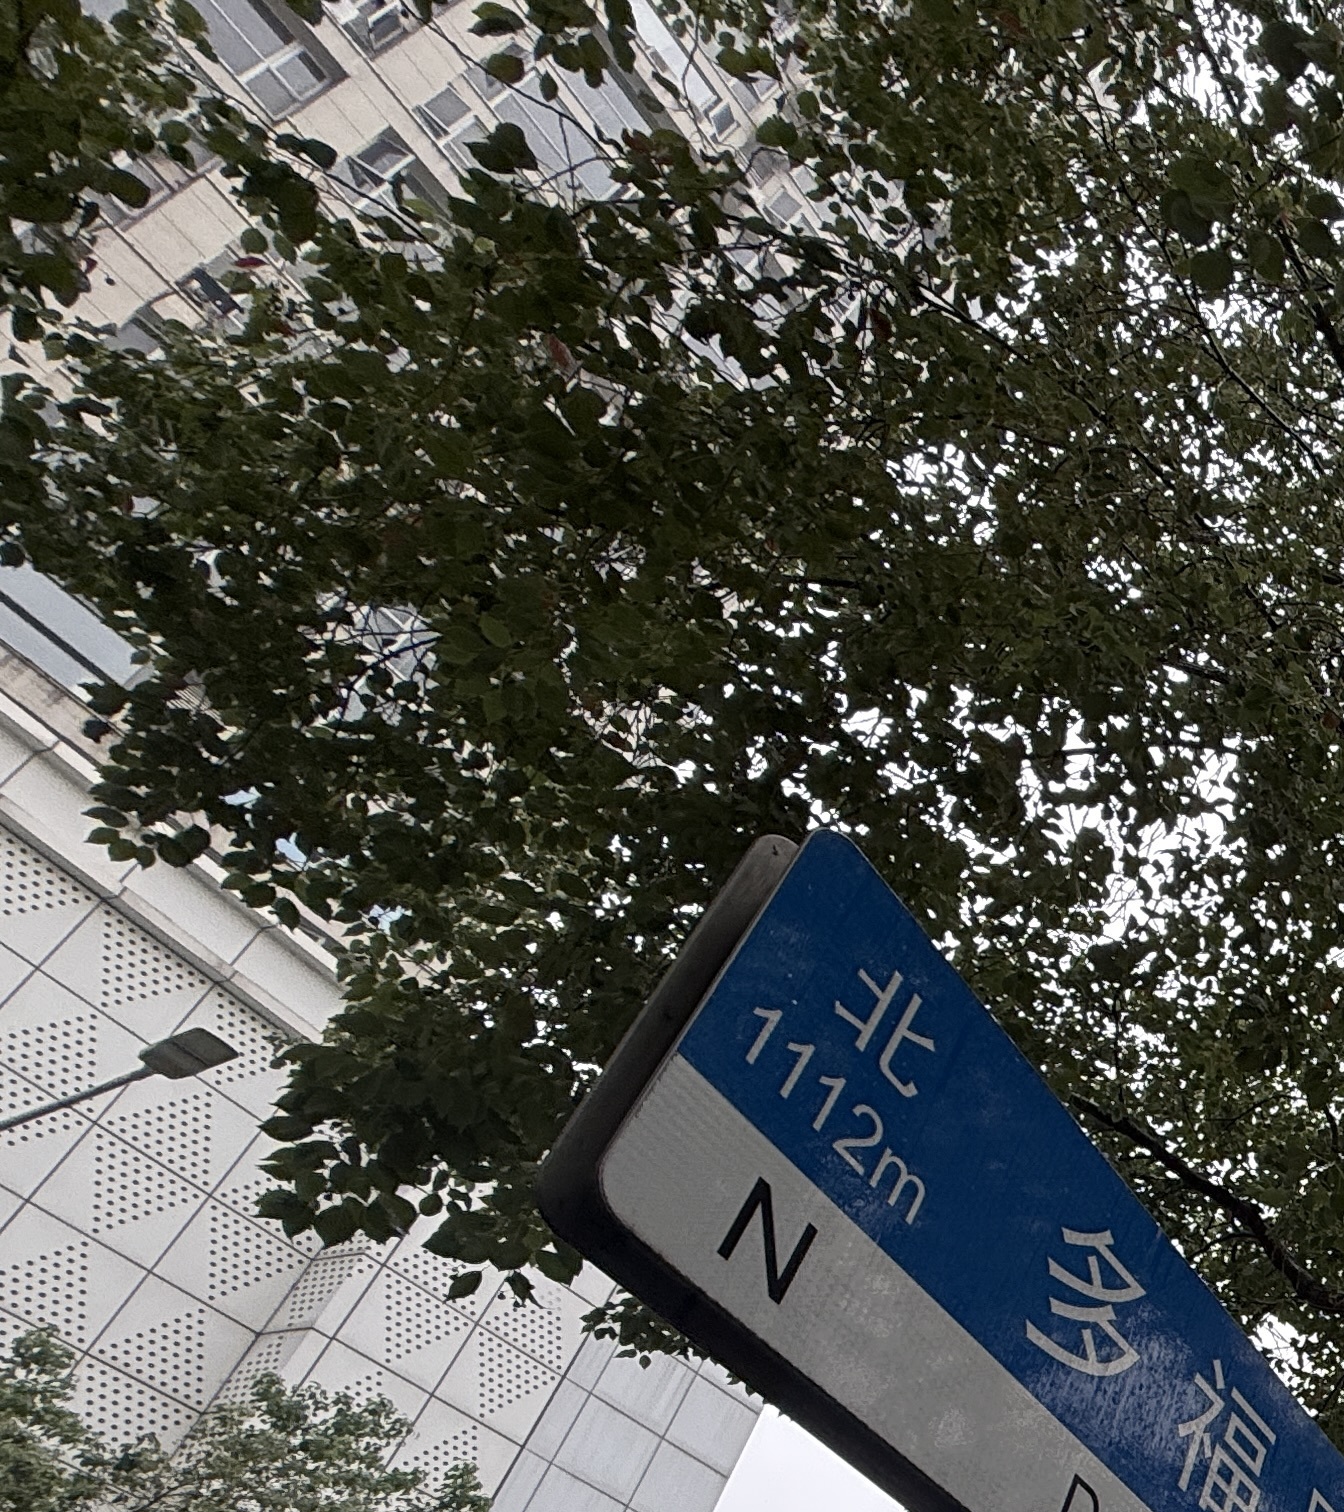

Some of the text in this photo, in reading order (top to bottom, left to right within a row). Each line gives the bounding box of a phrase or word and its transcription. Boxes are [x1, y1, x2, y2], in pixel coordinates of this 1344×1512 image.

[834, 969, 938, 1098] 北
[743, 1006, 929, 1225] 1112m
[717, 1177, 819, 1304] N
